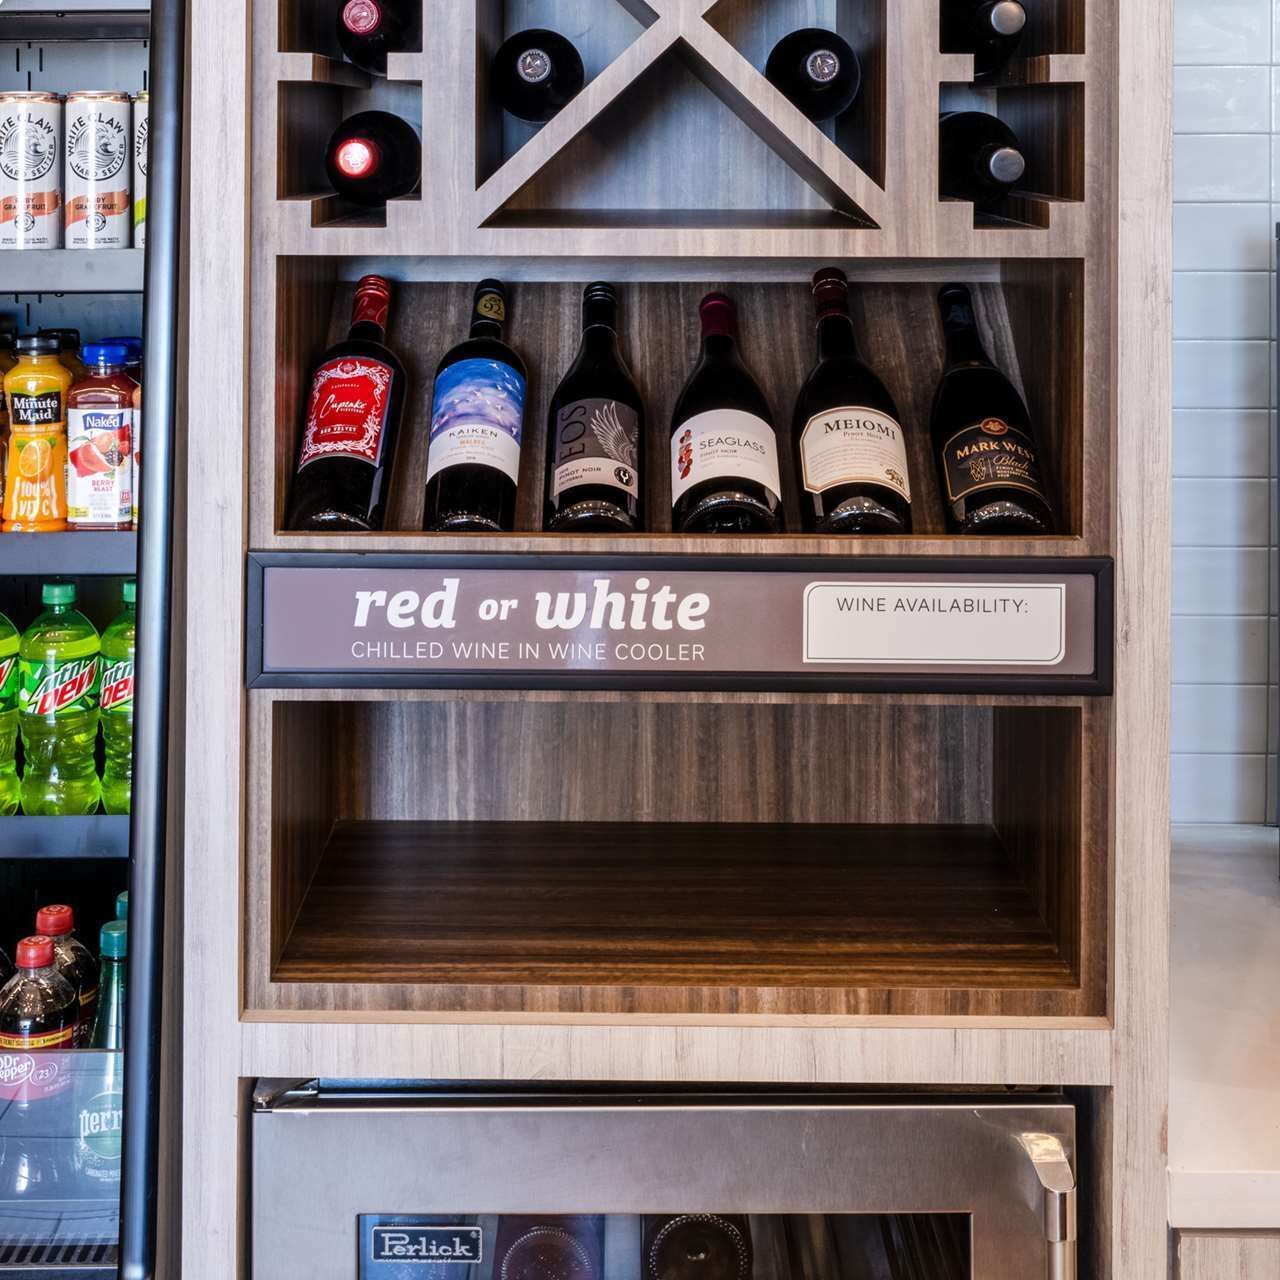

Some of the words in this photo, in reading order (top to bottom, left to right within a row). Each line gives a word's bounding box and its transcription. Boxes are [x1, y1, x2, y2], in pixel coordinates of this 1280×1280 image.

[17, 113, 54, 135] CLAW
[66, 116, 86, 157] WHITE
[13, 397, 58, 409] Minute
[19, 408, 52, 421] Maid
[86, 413, 120, 429] Naked
[448, 428, 499, 439] KAIKEN
[823, 419, 896, 441] MEIOMI
[699, 436, 766, 455] SEAGLASS
[955, 440, 1000, 460] MARK
[91, 479, 115, 487] BERRY
[353, 577, 458, 630] red
[477, 594, 519, 624] or
[535, 577, 711, 631] white
[836, 597, 889, 614] WINE
[893, 597, 1030, 615] AVAILABILITY:
[351, 641, 445, 660] CHILLED
[452, 641, 510, 660] WINE
[518, 641, 540, 659] IN
[548, 641, 610, 660] WINE
[614, 641, 706, 662] COOLER
[37, 1070, 50, 1078] 23
[79, 1109, 123, 1148] perr
[380, 1232, 473, 1257] Perlick
